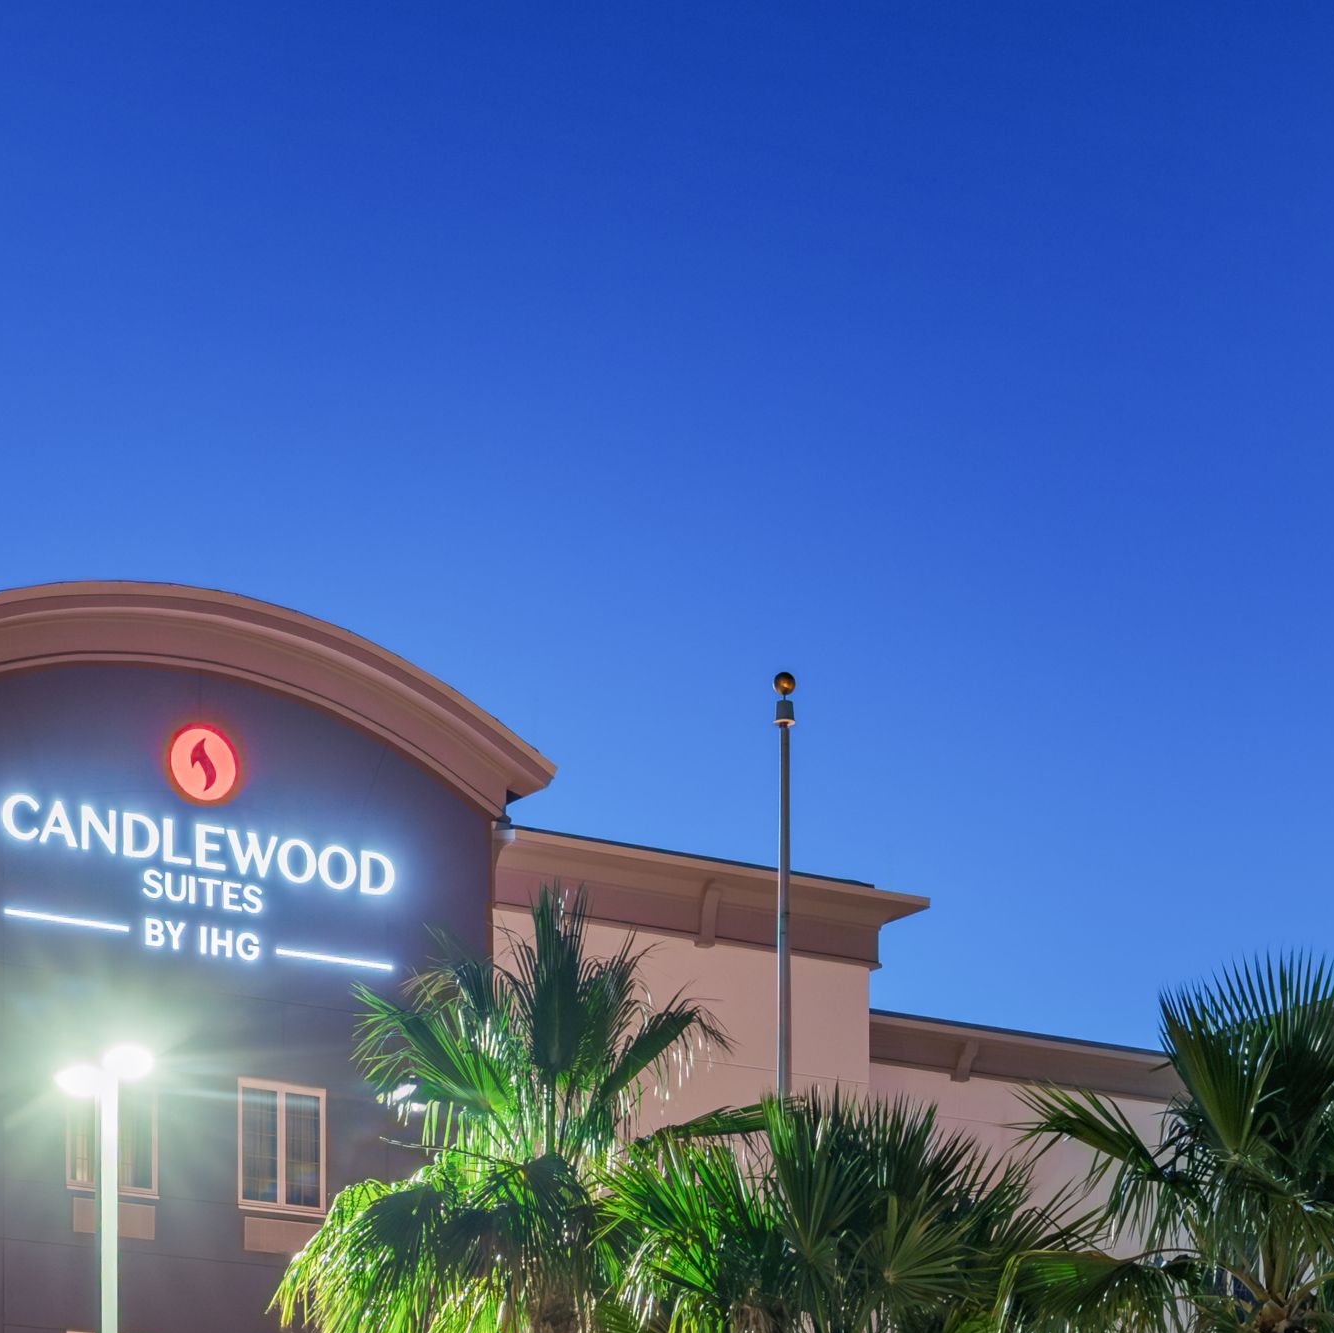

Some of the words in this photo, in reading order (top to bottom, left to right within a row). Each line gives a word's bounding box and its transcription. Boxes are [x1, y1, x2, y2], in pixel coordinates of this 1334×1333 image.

[2, 794, 395, 895] CANDLEWOOD
[142, 869, 263, 914] SUITES
[145, 917, 186, 950] BY
[199, 926, 260, 961] IHG
